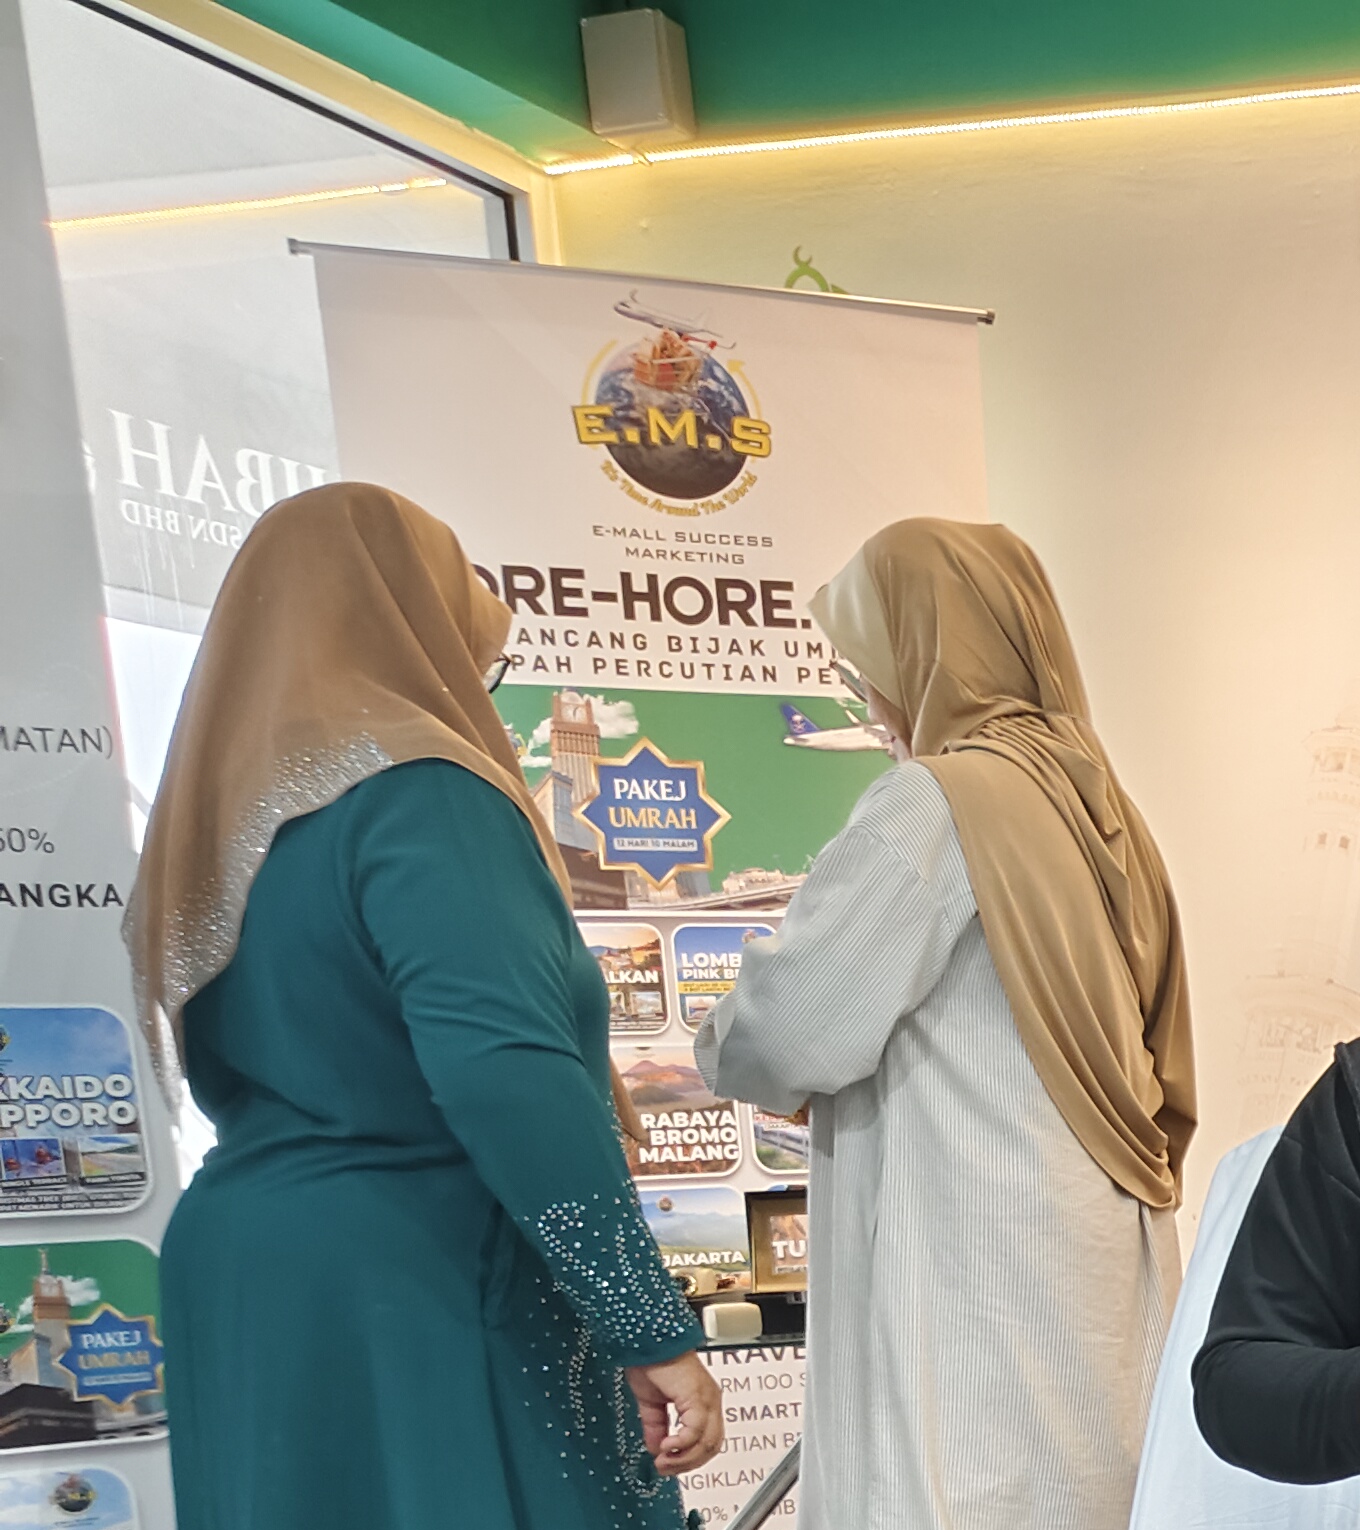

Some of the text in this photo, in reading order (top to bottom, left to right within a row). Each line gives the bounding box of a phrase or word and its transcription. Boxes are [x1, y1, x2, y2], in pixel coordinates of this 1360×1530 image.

[572, 405, 771, 458] E.M.S
[592, 525, 773, 548] E-MALL SUCCESS
[625, 547, 745, 565] MARKETING
[667, 635, 766, 657] BIJAK
[593, 657, 778, 683] PERCUTIAN
[797, 666, 846, 684] PE
[613, 778, 686, 801] PAKEJ
[608, 806, 698, 830] UMRAH
[683, 968, 720, 980] PINK
[650, 1128, 738, 1146] BROMO
[639, 1144, 739, 1164] MALANG
[82, 1330, 142, 1349] PAKEJ
[721, 1376, 750, 1393] RM
[725, 1402, 802, 1423] SMART
